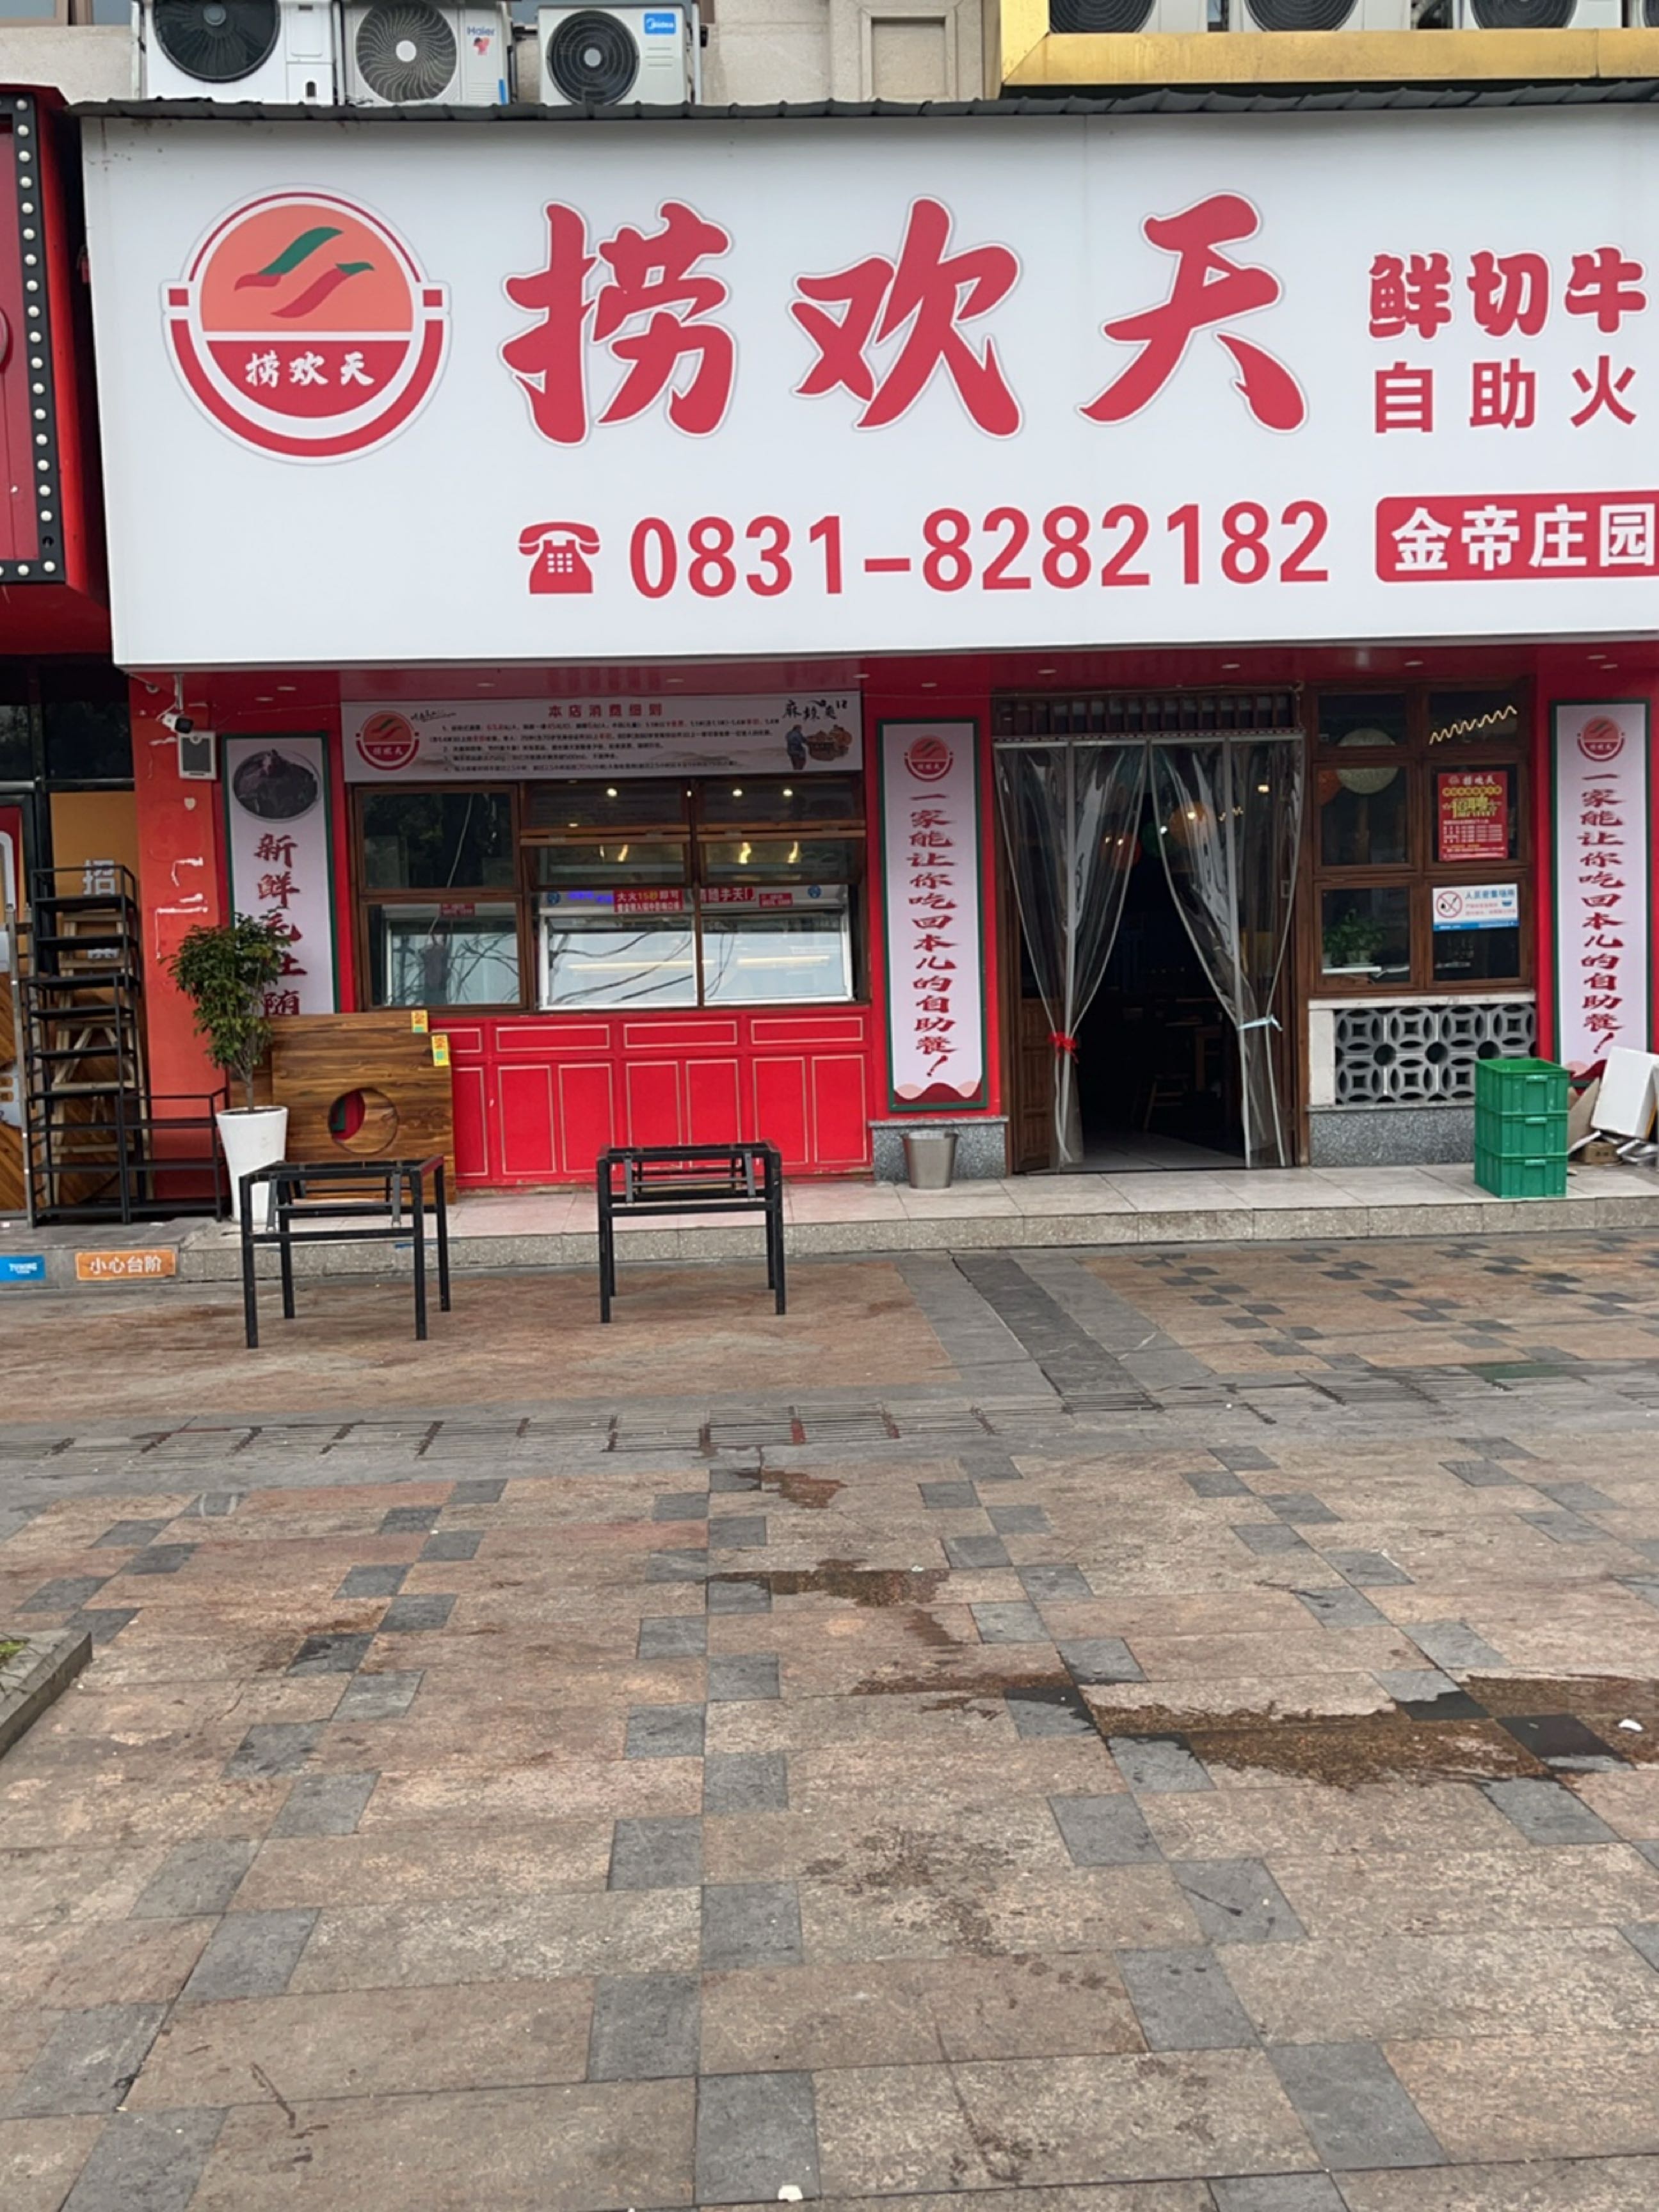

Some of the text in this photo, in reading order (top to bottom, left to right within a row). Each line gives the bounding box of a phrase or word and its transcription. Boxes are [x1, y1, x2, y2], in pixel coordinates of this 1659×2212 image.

[467, 26, 495, 36] Haier
[503, 195, 1304, 444] 捞欢天
[1369, 247, 1646, 339] 鲜切牛
[245, 350, 375, 388] 捞欢天
[1375, 355, 1637, 433] 自助火
[630, 499, 1329, 599] 0831-8282182
[1391, 504, 1655, 571] 金帝庄园
[90, 1255, 162, 1274] 小心台阶
